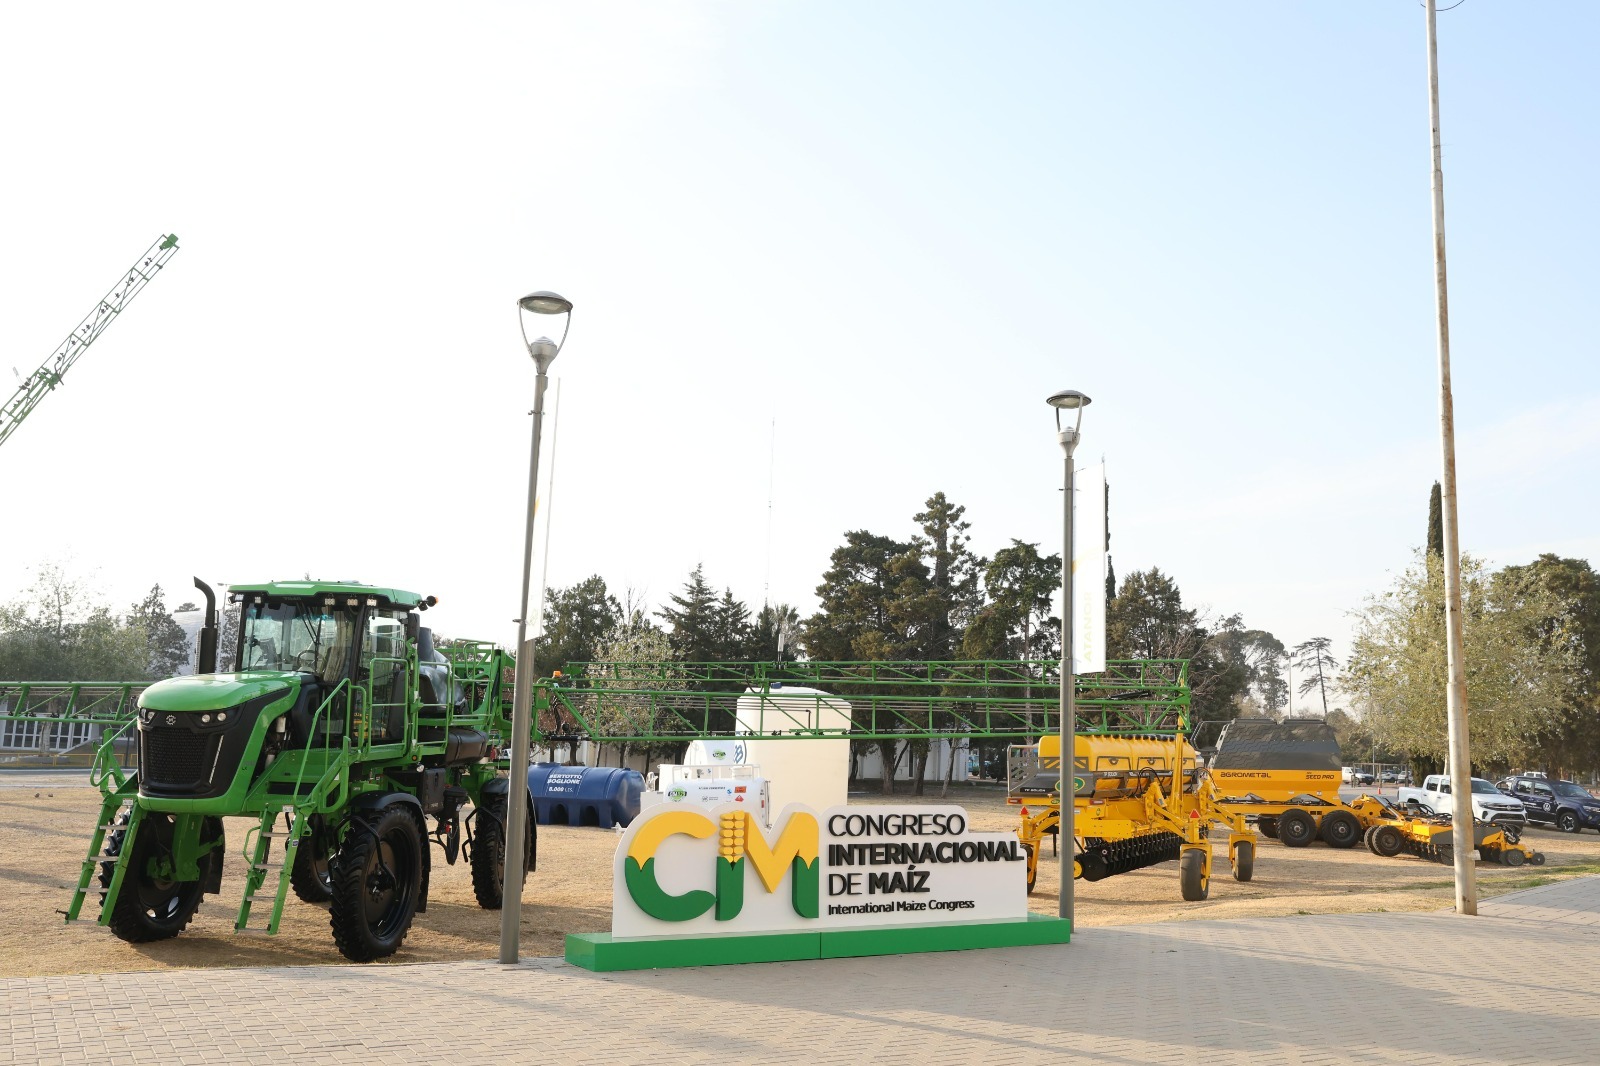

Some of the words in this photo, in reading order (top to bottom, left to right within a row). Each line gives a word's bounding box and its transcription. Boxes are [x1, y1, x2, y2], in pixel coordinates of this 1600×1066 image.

[1083, 591, 1093, 664] ATANOR
[828, 813, 966, 837] CONGRESO
[828, 840, 1025, 867] INTERNACIONAL
[828, 872, 863, 896] DE
[868, 864, 931, 895] MAÍZ
[828, 901, 895, 915] International
[896, 901, 927, 912] Maize
[928, 899, 975, 911] Congress
